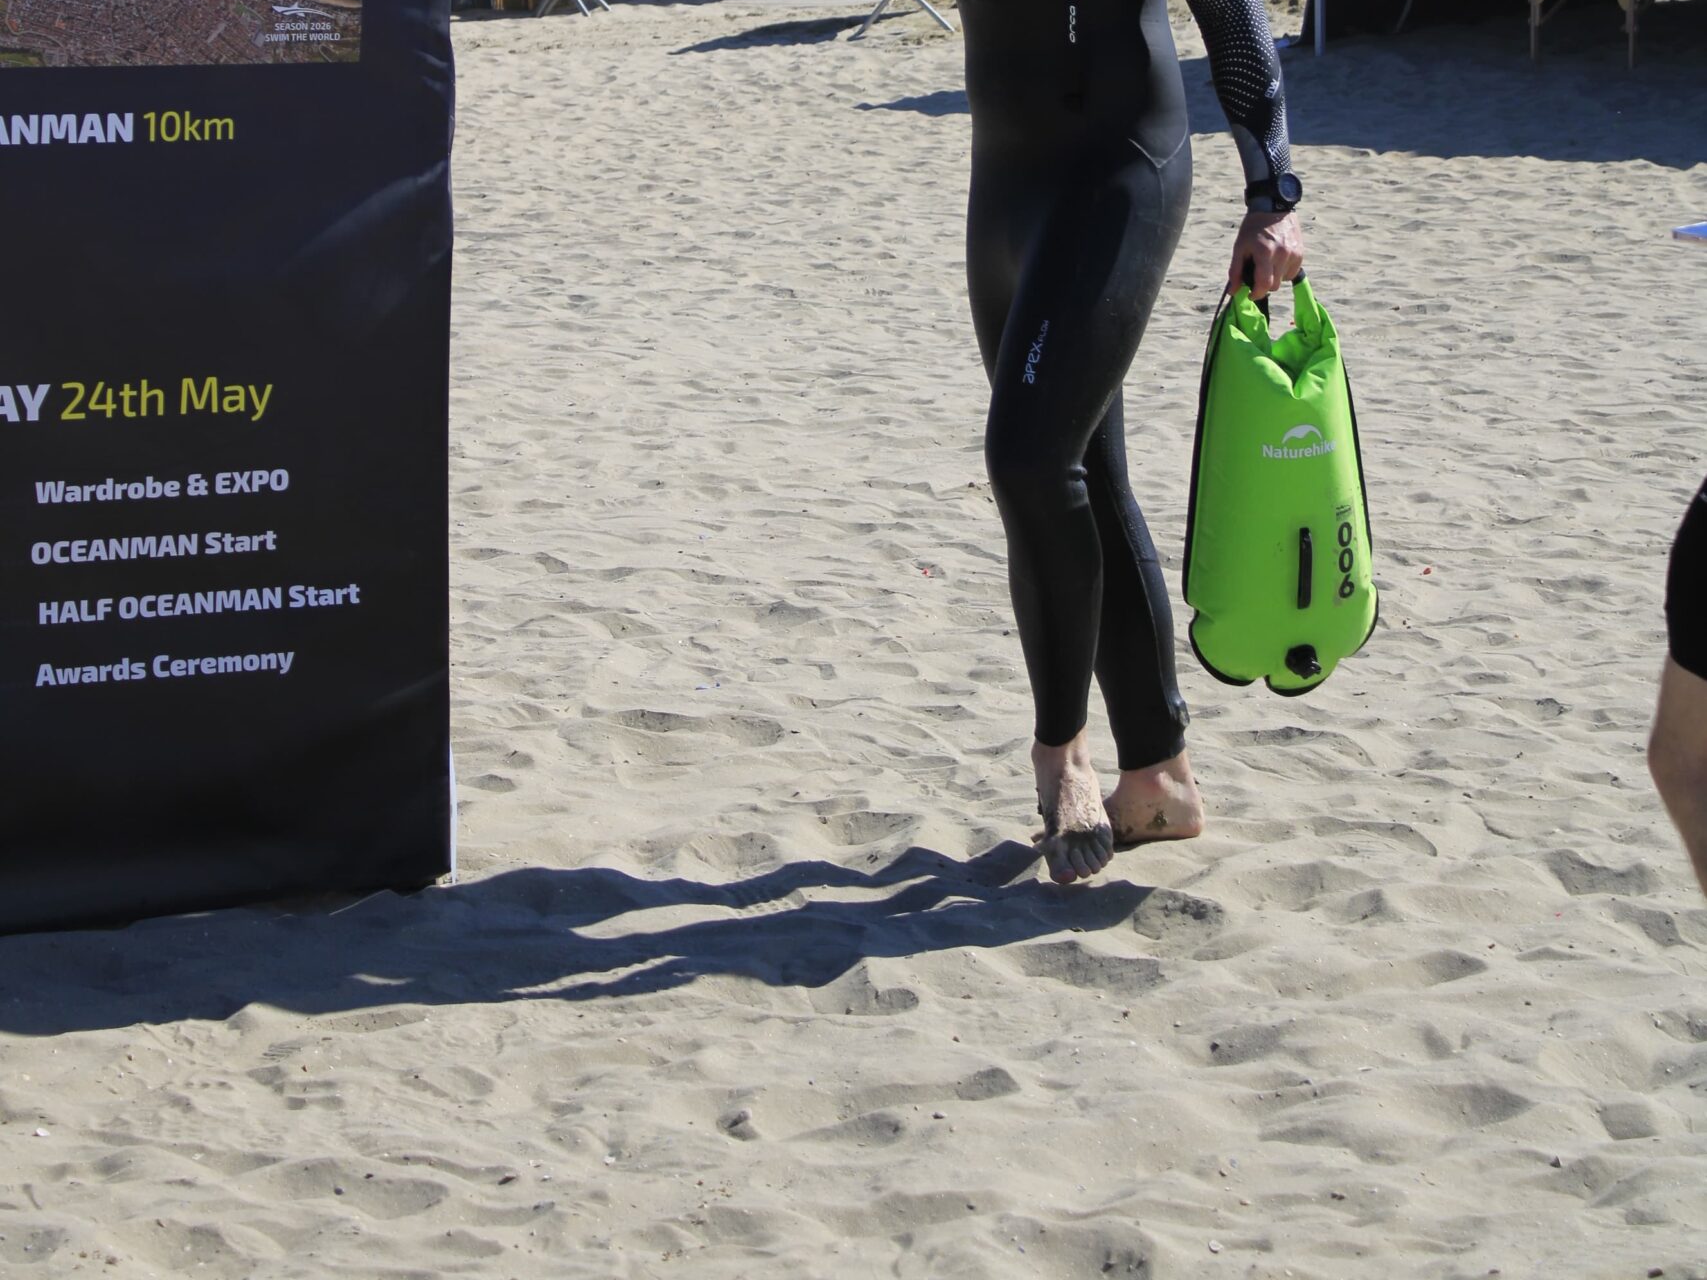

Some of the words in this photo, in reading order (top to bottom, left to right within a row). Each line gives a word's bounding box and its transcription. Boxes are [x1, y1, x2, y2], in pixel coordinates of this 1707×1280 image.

[265, 33, 290, 42] SWIM
[291, 33, 308, 41] THE
[309, 32, 341, 41] WORLD
[275, 22, 308, 31] SEASON
[310, 22, 332, 31] 2026
[143, 111, 235, 142] 10km
[60, 379, 165, 420] 24th
[180, 376, 273, 421] May
[1262, 440, 1337, 459] Naturehike
[35, 476, 181, 504] Wardrobe
[187, 473, 208, 496] &
[215, 469, 289, 495] EXPO
[31, 533, 198, 565] OCEANMAN
[204, 531, 277, 555] Start
[1337, 522, 1355, 599] 006
[39, 597, 113, 625] HALF
[118, 586, 282, 619] OCEANMAN
[288, 583, 360, 608] Start
[35, 657, 146, 687] Awards
[152, 651, 295, 678] Ceremony
